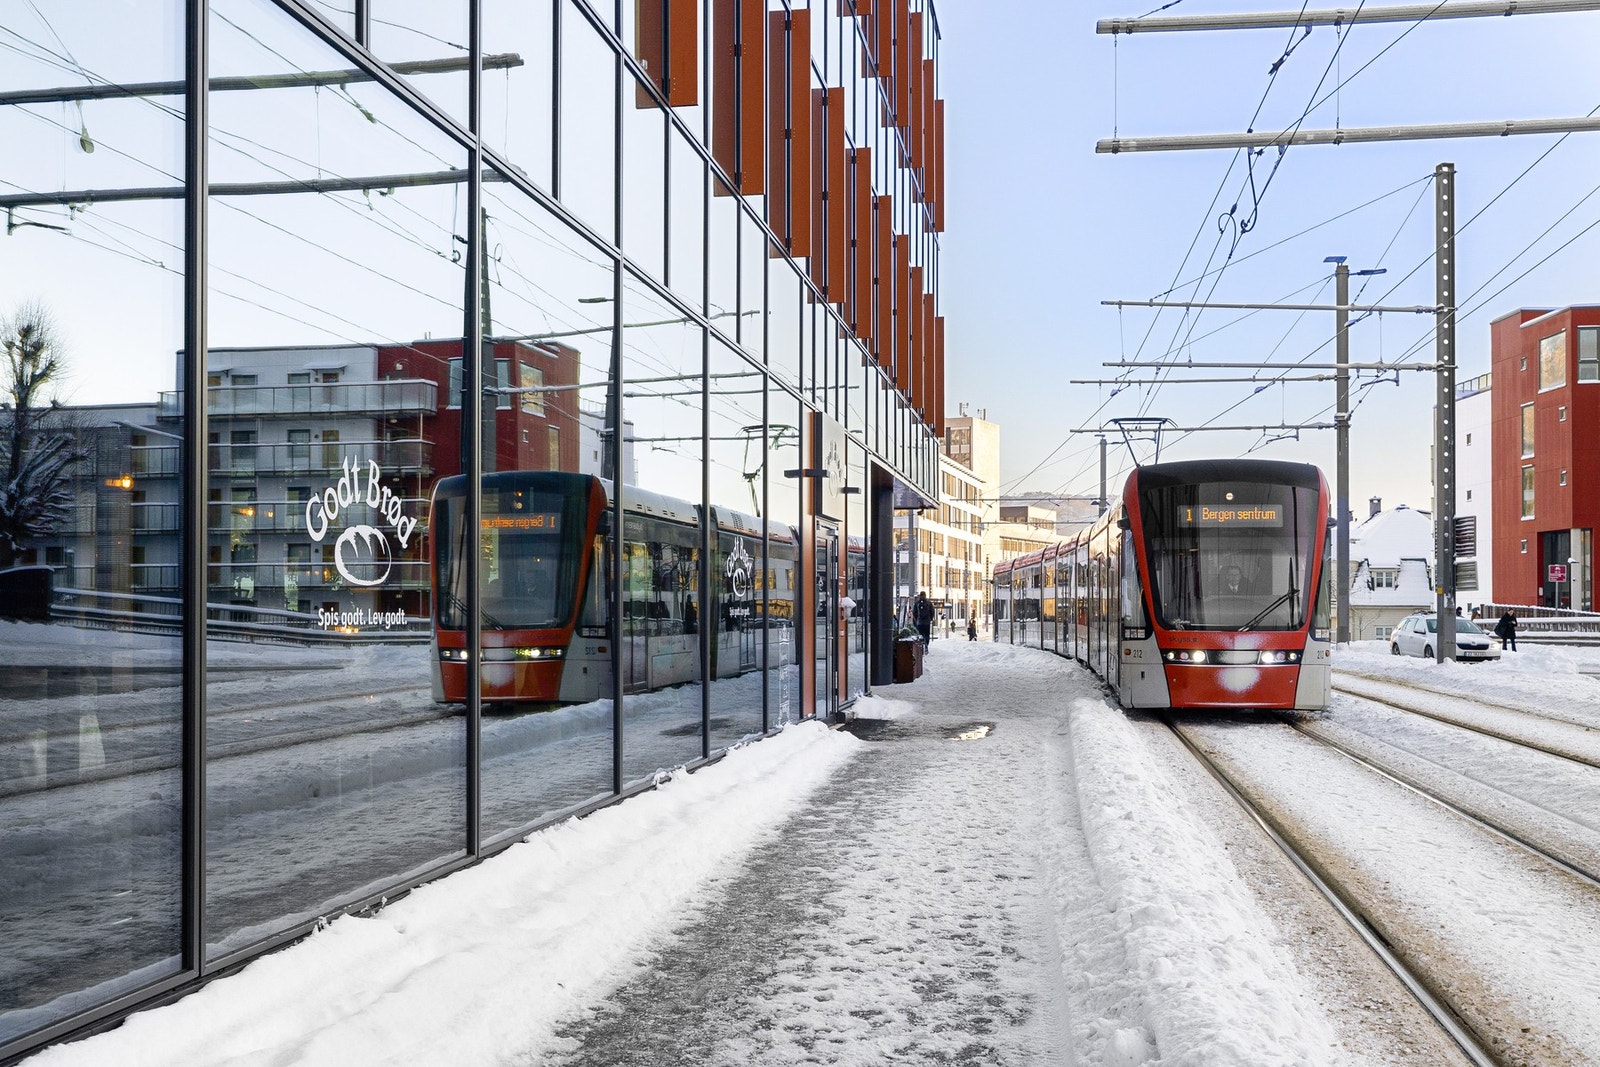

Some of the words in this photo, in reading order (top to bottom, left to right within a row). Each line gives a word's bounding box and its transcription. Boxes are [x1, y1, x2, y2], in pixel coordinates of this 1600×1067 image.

[306, 455, 362, 542] Godt
[366, 459, 418, 549] Brød
[1186, 509, 1193, 522] 1
[1202, 507, 1236, 522] Bergen
[1237, 506, 1276, 520] sentrum
[318, 607, 339, 630] Spis
[341, 607, 366, 629] godt.
[368, 608, 384, 625] Lev
[385, 608, 408, 629] godt.
